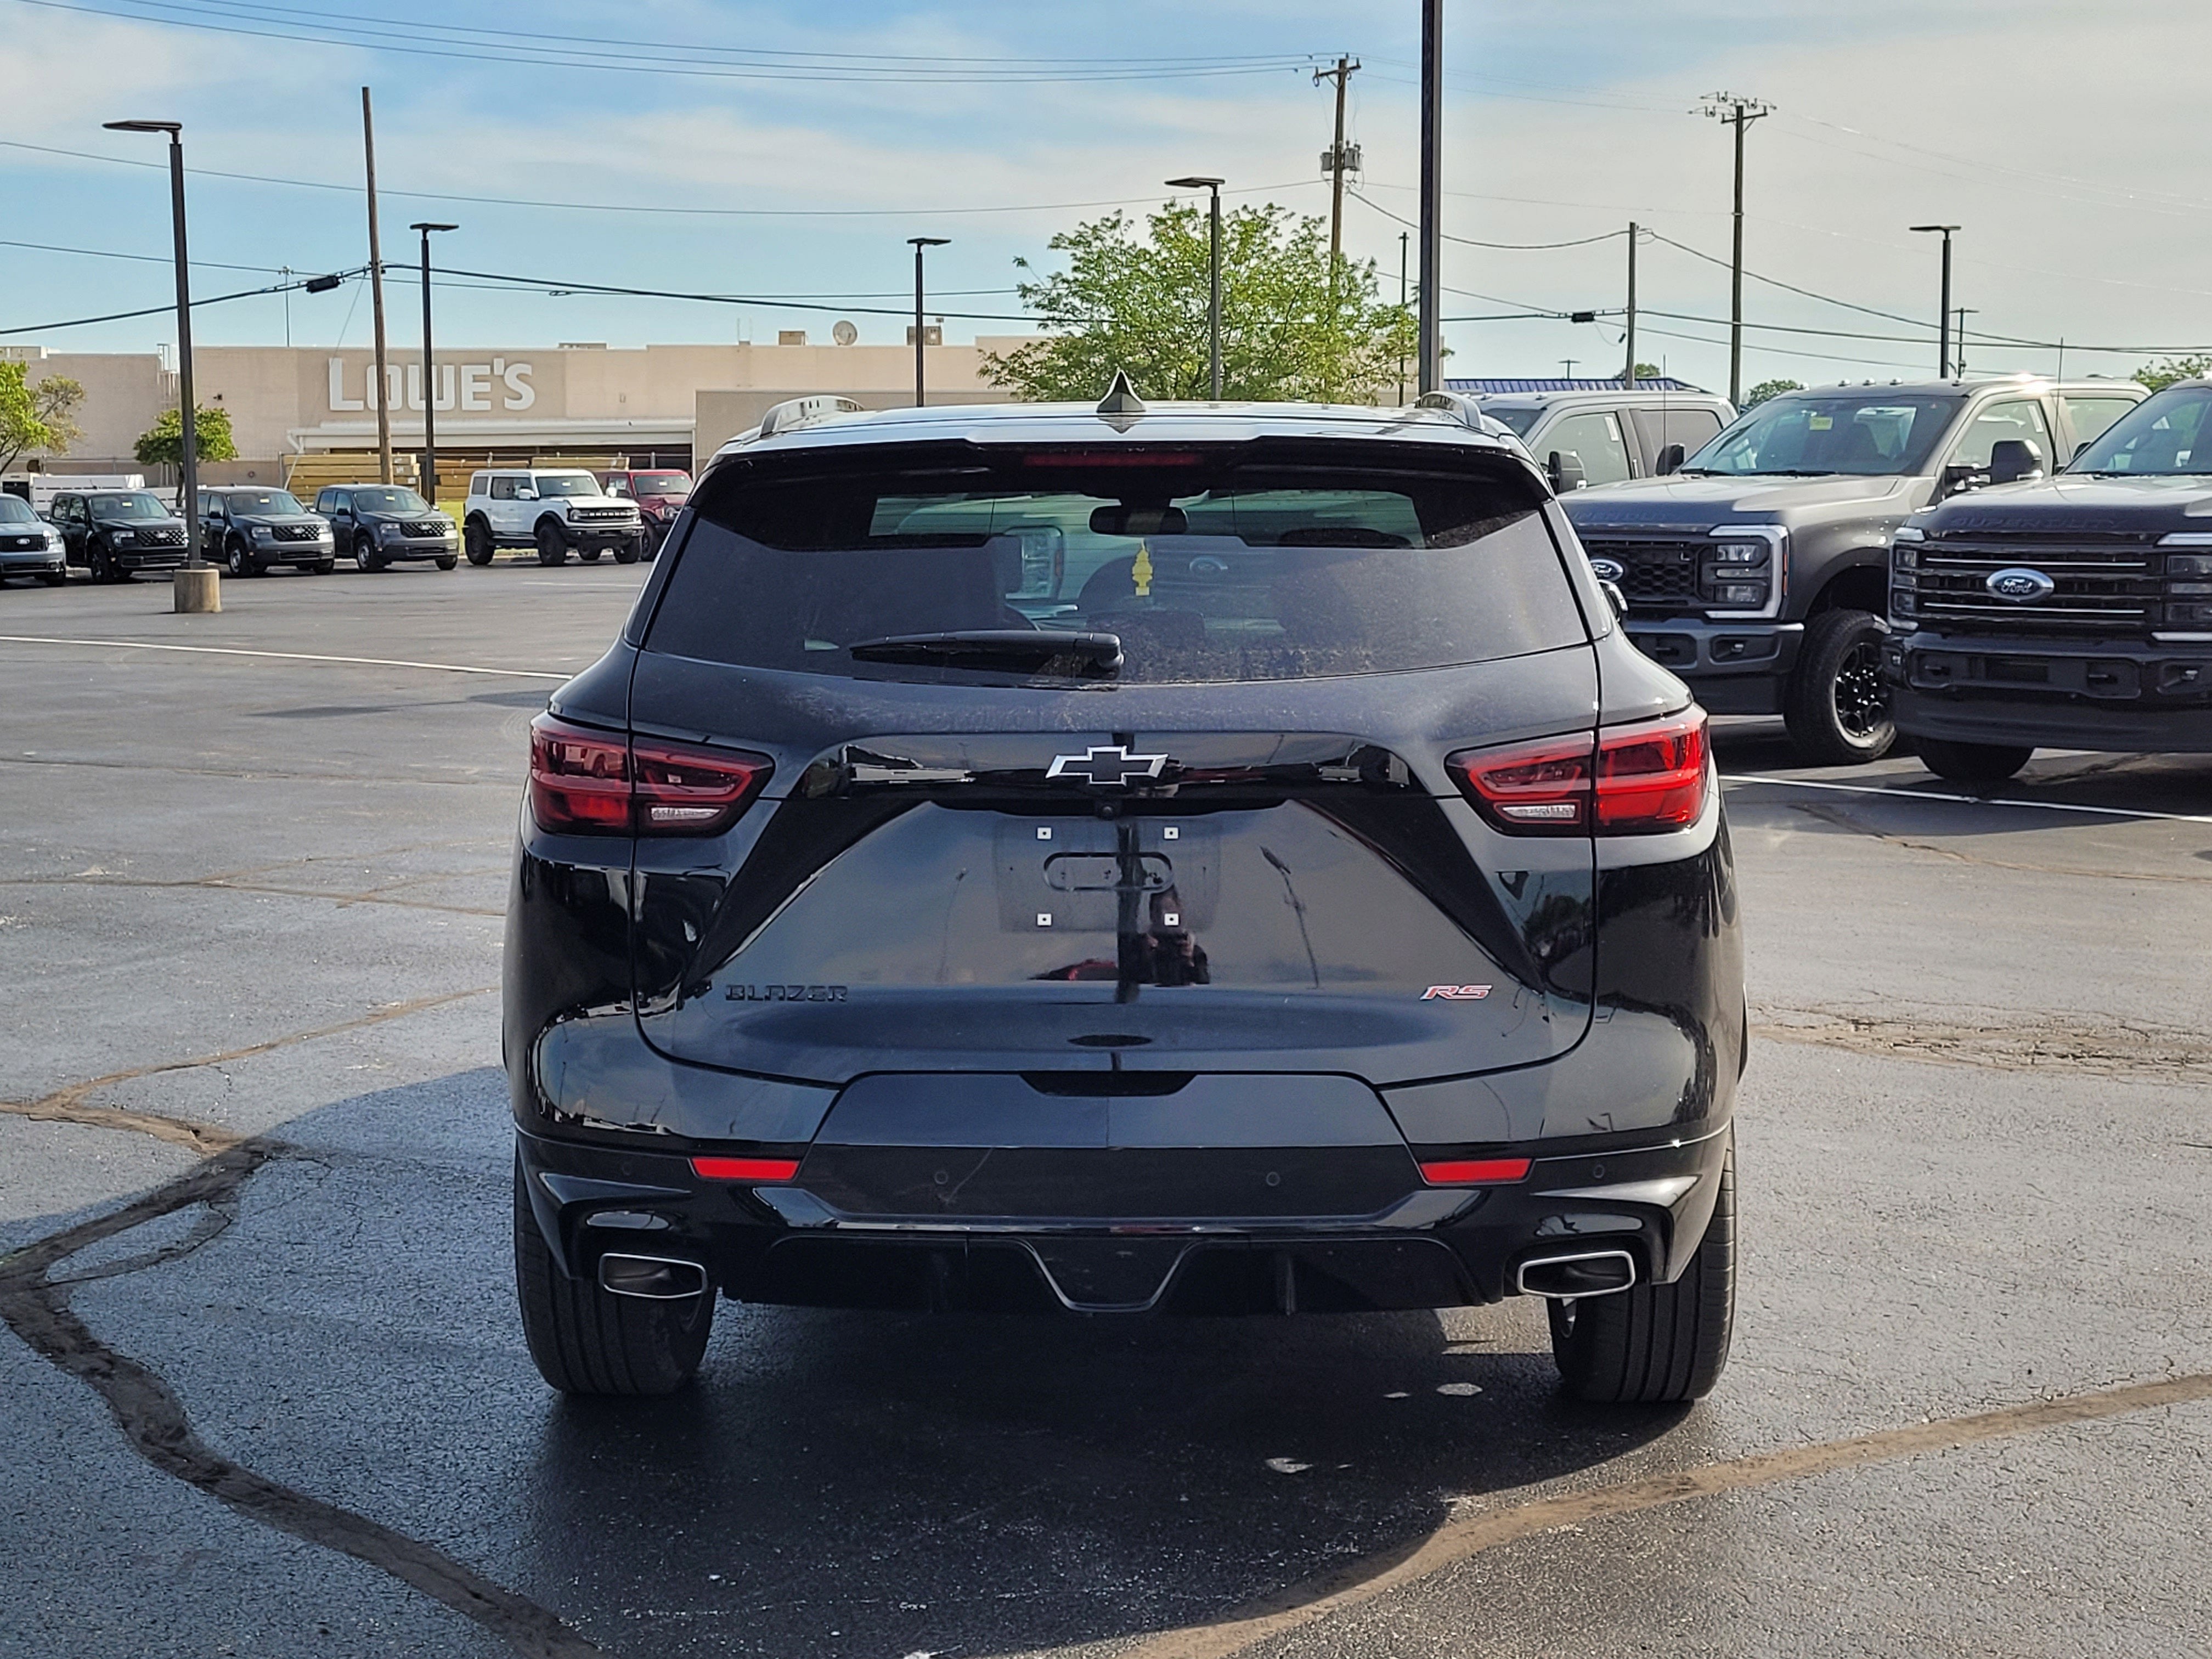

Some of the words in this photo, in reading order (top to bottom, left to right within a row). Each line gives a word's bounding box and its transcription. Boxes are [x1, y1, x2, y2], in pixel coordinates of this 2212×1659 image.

[329, 358, 535, 410] LOWE'S
[2001, 578, 2033, 593] Ford
[725, 985, 848, 1002] BLAZER
[1419, 984, 1492, 1000] RS
